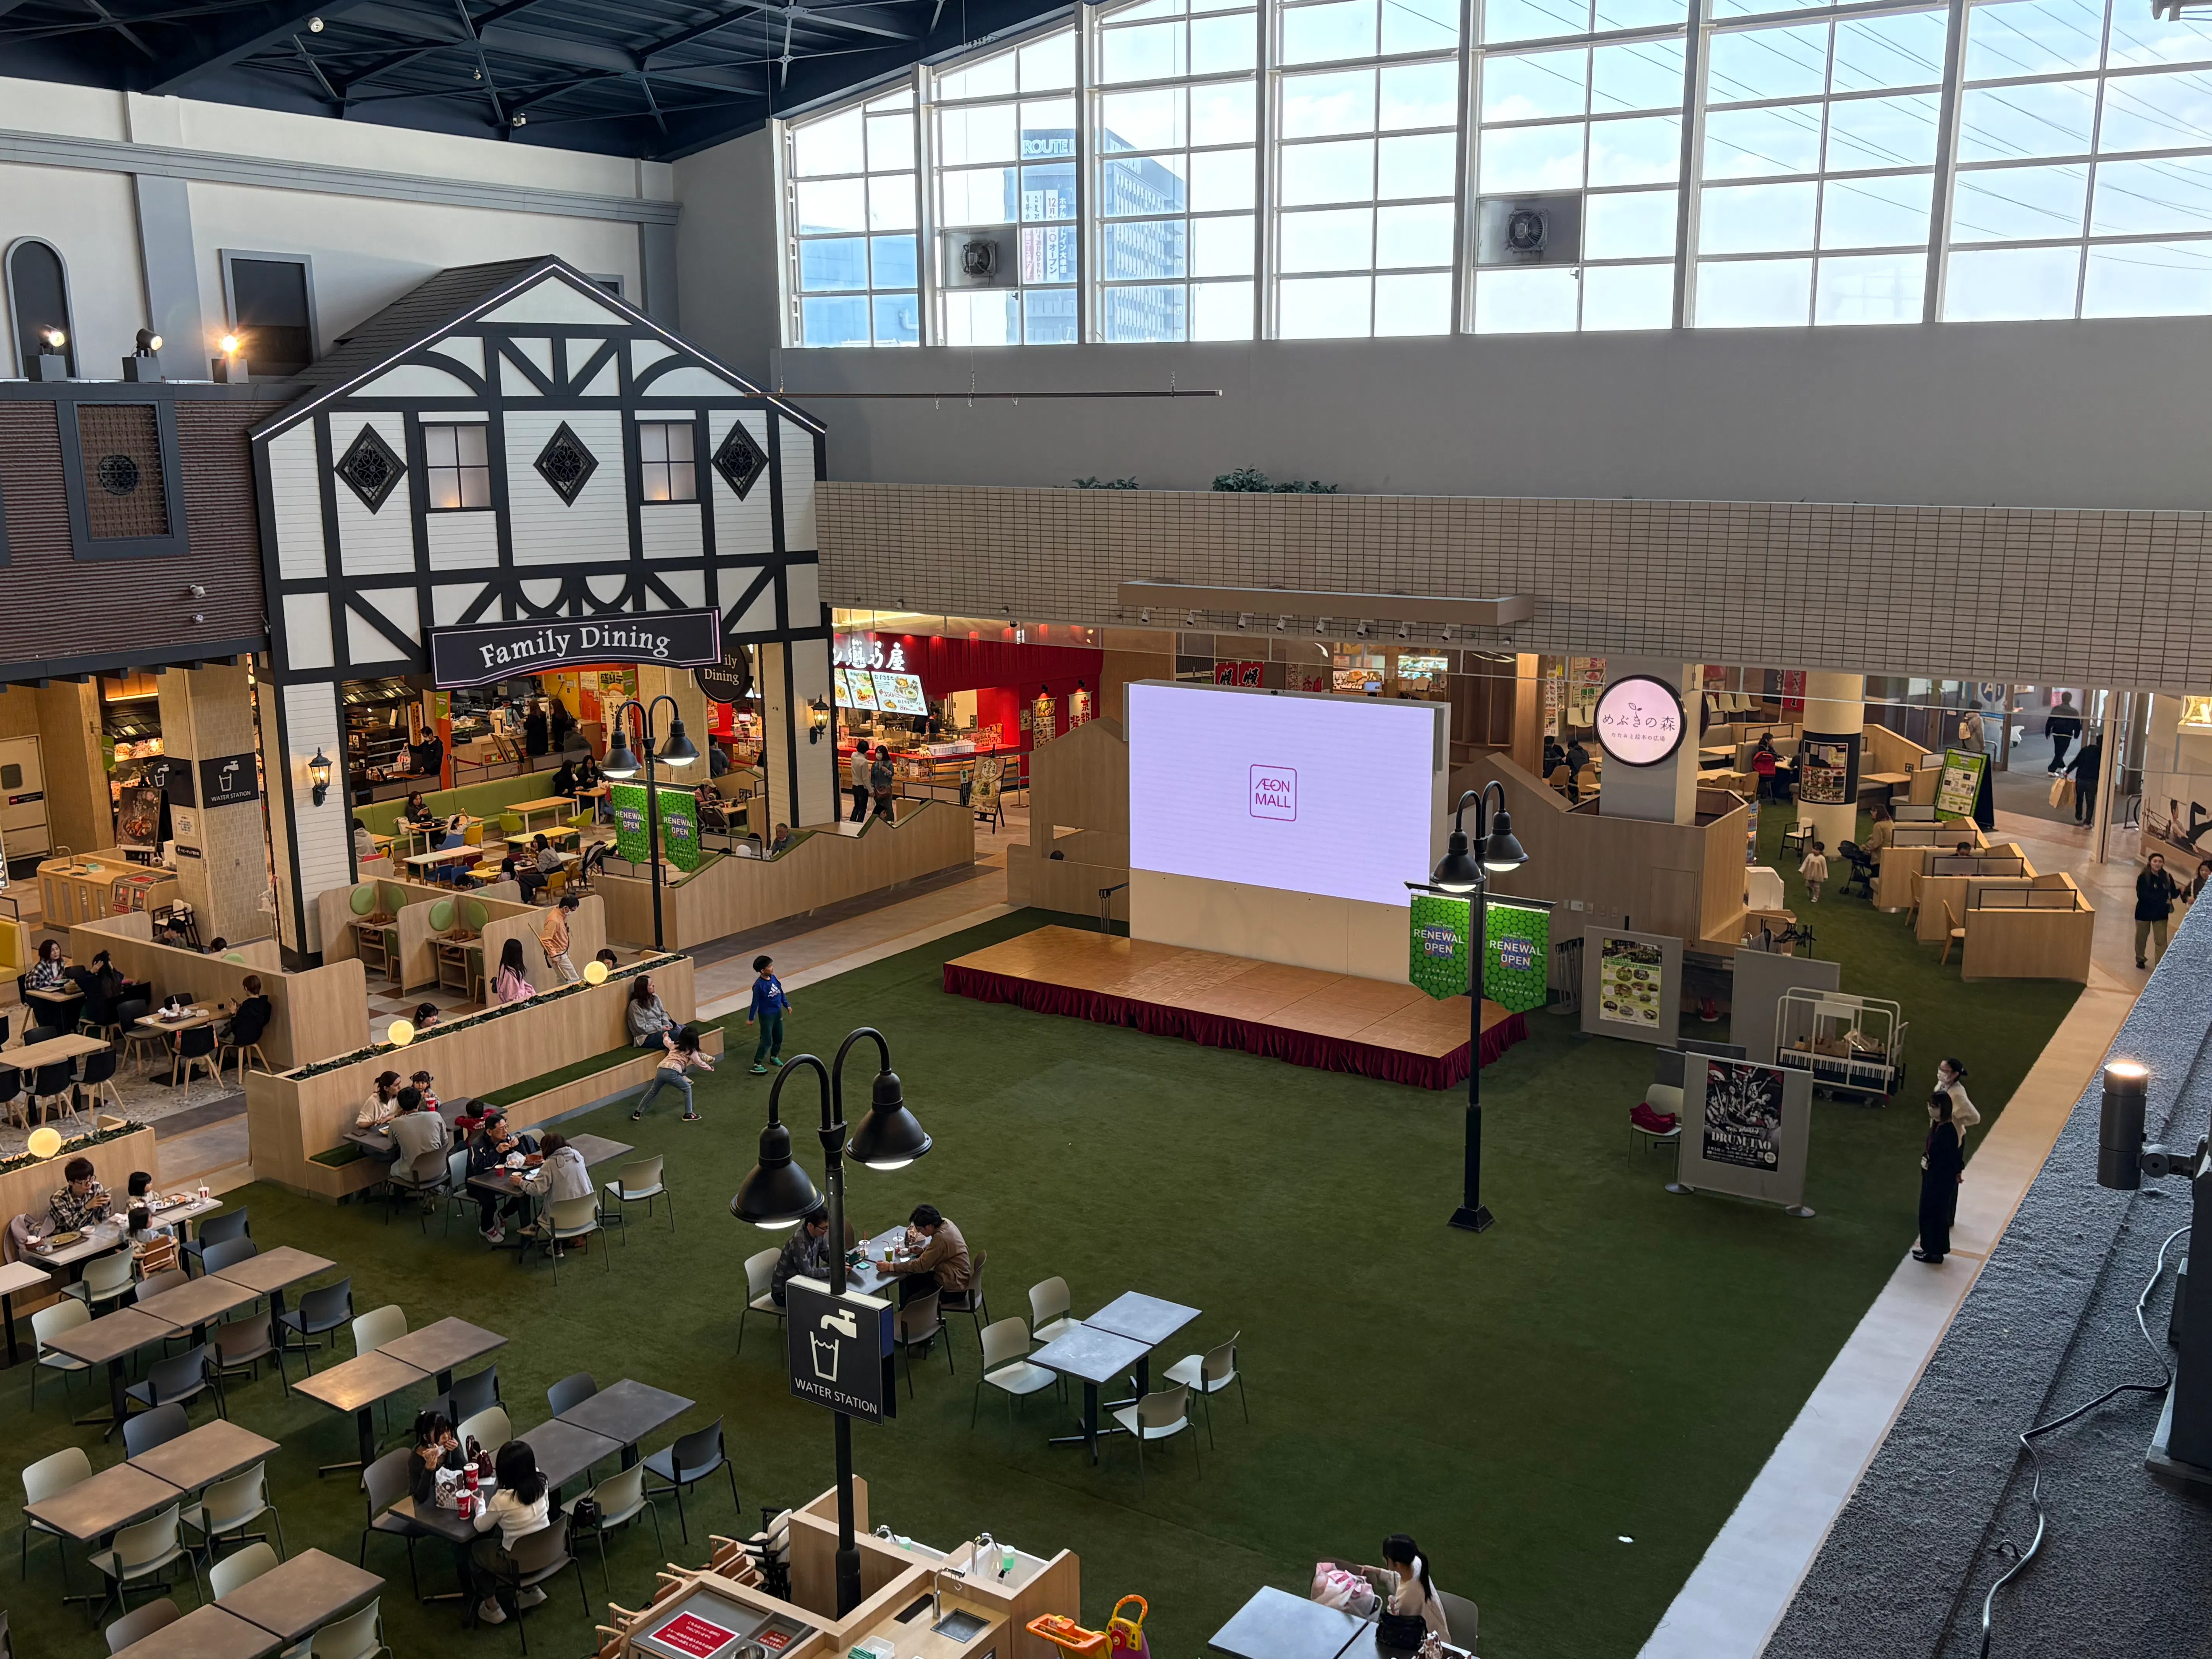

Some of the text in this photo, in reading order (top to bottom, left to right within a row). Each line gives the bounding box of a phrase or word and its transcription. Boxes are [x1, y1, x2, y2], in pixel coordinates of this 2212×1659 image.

[1023, 139, 1068, 154] ROUTE
[479, 625, 670, 668] Family Dining
[704, 668, 739, 685] Dining
[1081, 697, 1090, 723] 京都
[1602, 714, 1675, 732] めぶきの森
[211, 790, 251, 802] WATER STATION
[1255, 793, 1291, 808] MALL
[616, 811, 646, 821] RENEWAL
[663, 816, 695, 828] RENEWAL
[623, 821, 639, 830] OPEN
[672, 827, 689, 836] OPEN
[1414, 929, 1464, 944] RENEWAL
[1425, 942, 1453, 954] OPEN
[1490, 940, 1543, 956] RENEWAL
[1501, 954, 1530, 966] OPEN
[1711, 1131, 1771, 1150] DRUM TAO
[795, 1377, 877, 1414] WATER STATION
